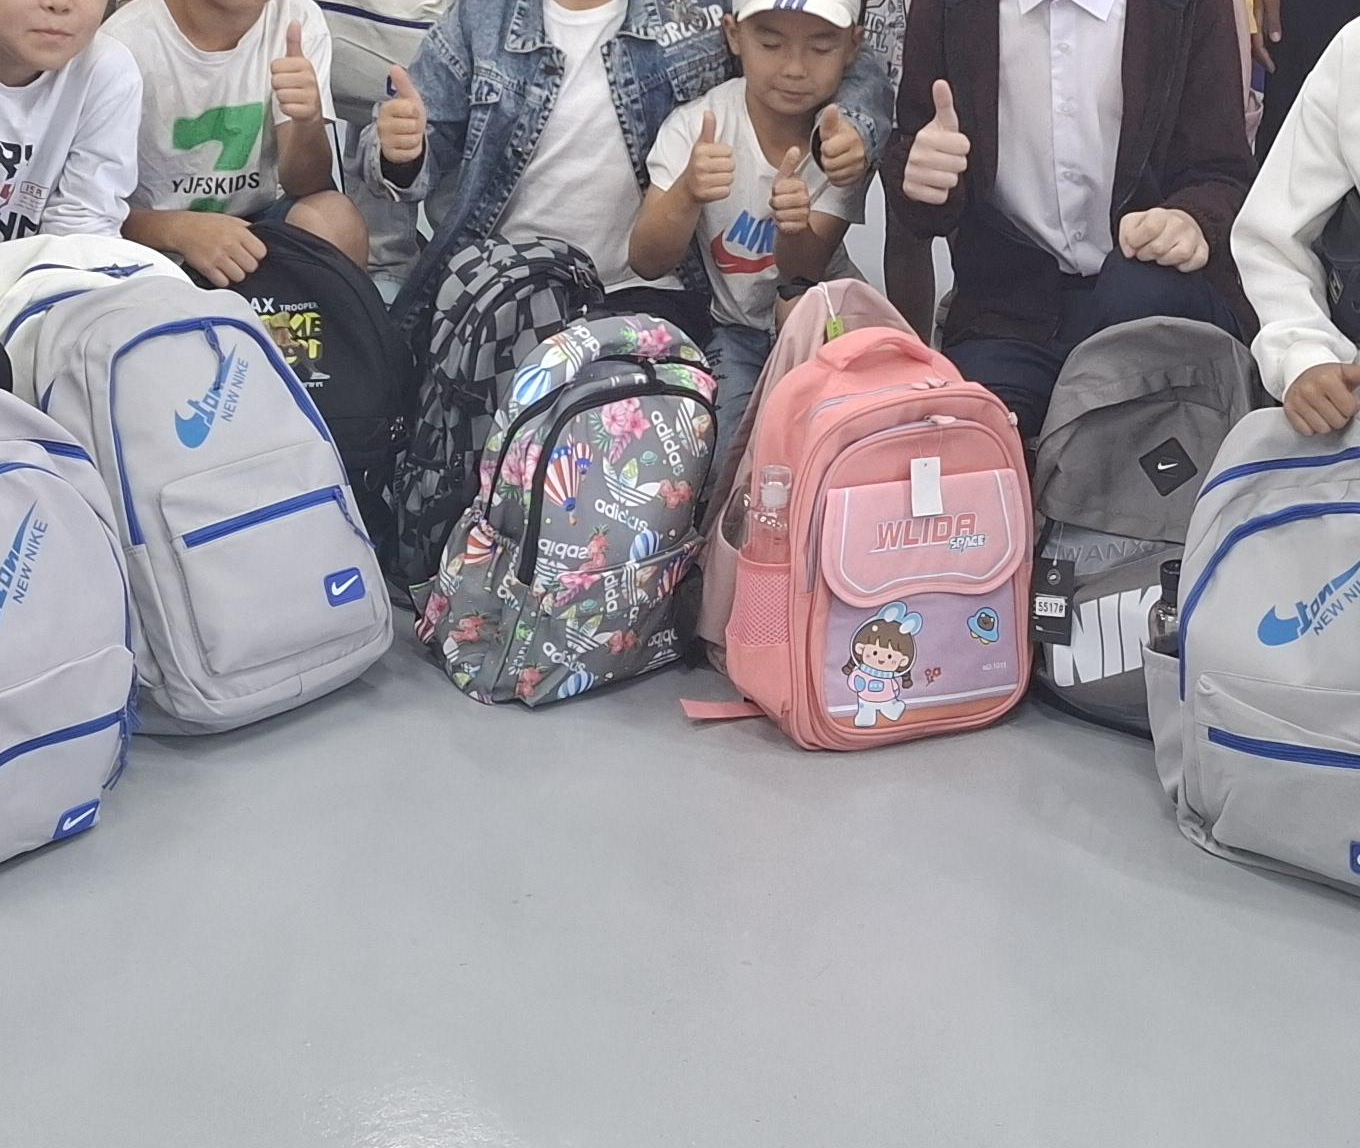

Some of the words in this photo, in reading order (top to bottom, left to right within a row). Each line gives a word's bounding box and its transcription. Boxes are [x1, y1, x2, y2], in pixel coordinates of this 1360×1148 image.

[172, 172, 260, 195] YJFSKIDS
[726, 210, 776, 254] NIK
[250, 297, 275, 313] AX
[221, 389, 240, 422] NEW
[231, 358, 249, 389] NIKE
[874, 512, 978, 551] WLIDA
[948, 534, 986, 551] SPACE
[13, 561, 33, 604] NEW
[25, 519, 48, 562] NIKE
[1037, 601, 1064, 614] 5517#
[1313, 599, 1344, 636] NEW
[1053, 584, 1162, 687] NIK
